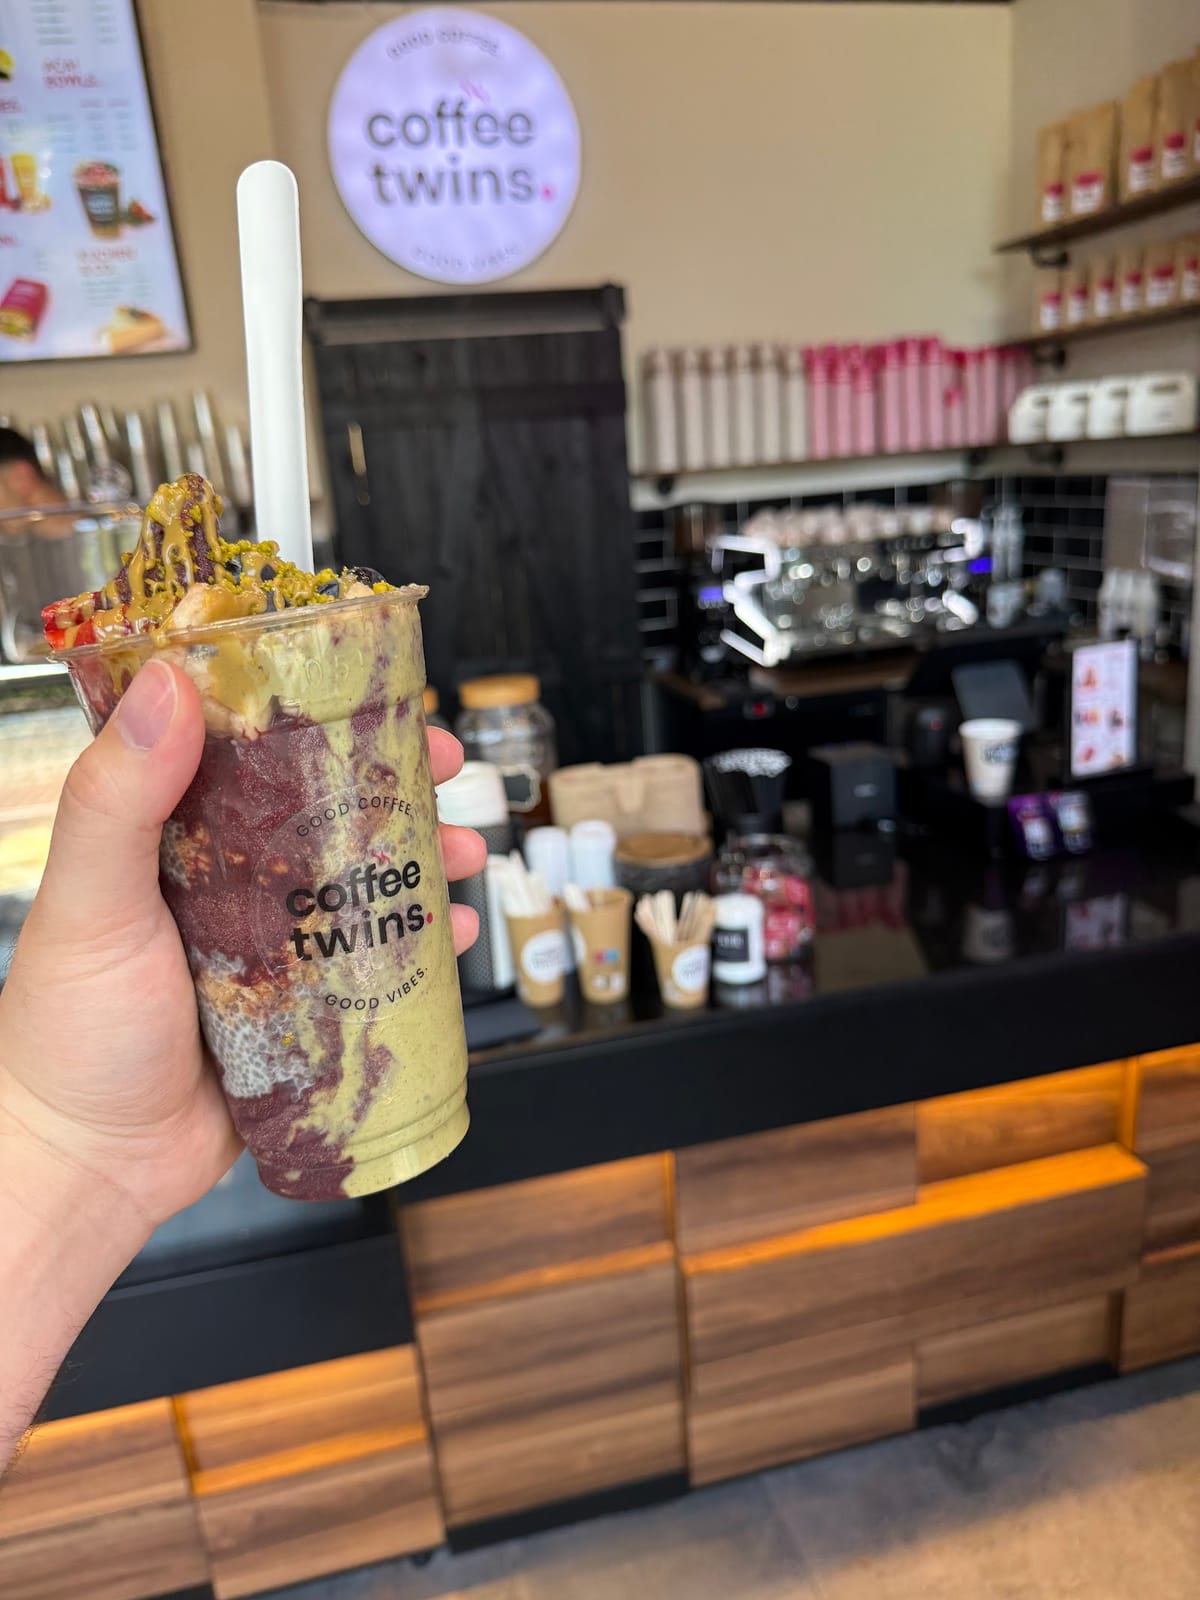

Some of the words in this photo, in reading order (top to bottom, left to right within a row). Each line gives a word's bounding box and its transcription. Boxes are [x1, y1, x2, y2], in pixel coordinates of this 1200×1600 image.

[366, 99, 535, 147] coffee
[371, 154, 553, 206] twins.
[296, 803, 350, 837] GOOD
[285, 860, 421, 918] coffee
[290, 903, 433, 962] twins.
[325, 994, 380, 1011] GOOD
[386, 966, 428, 1004] VIBES.
